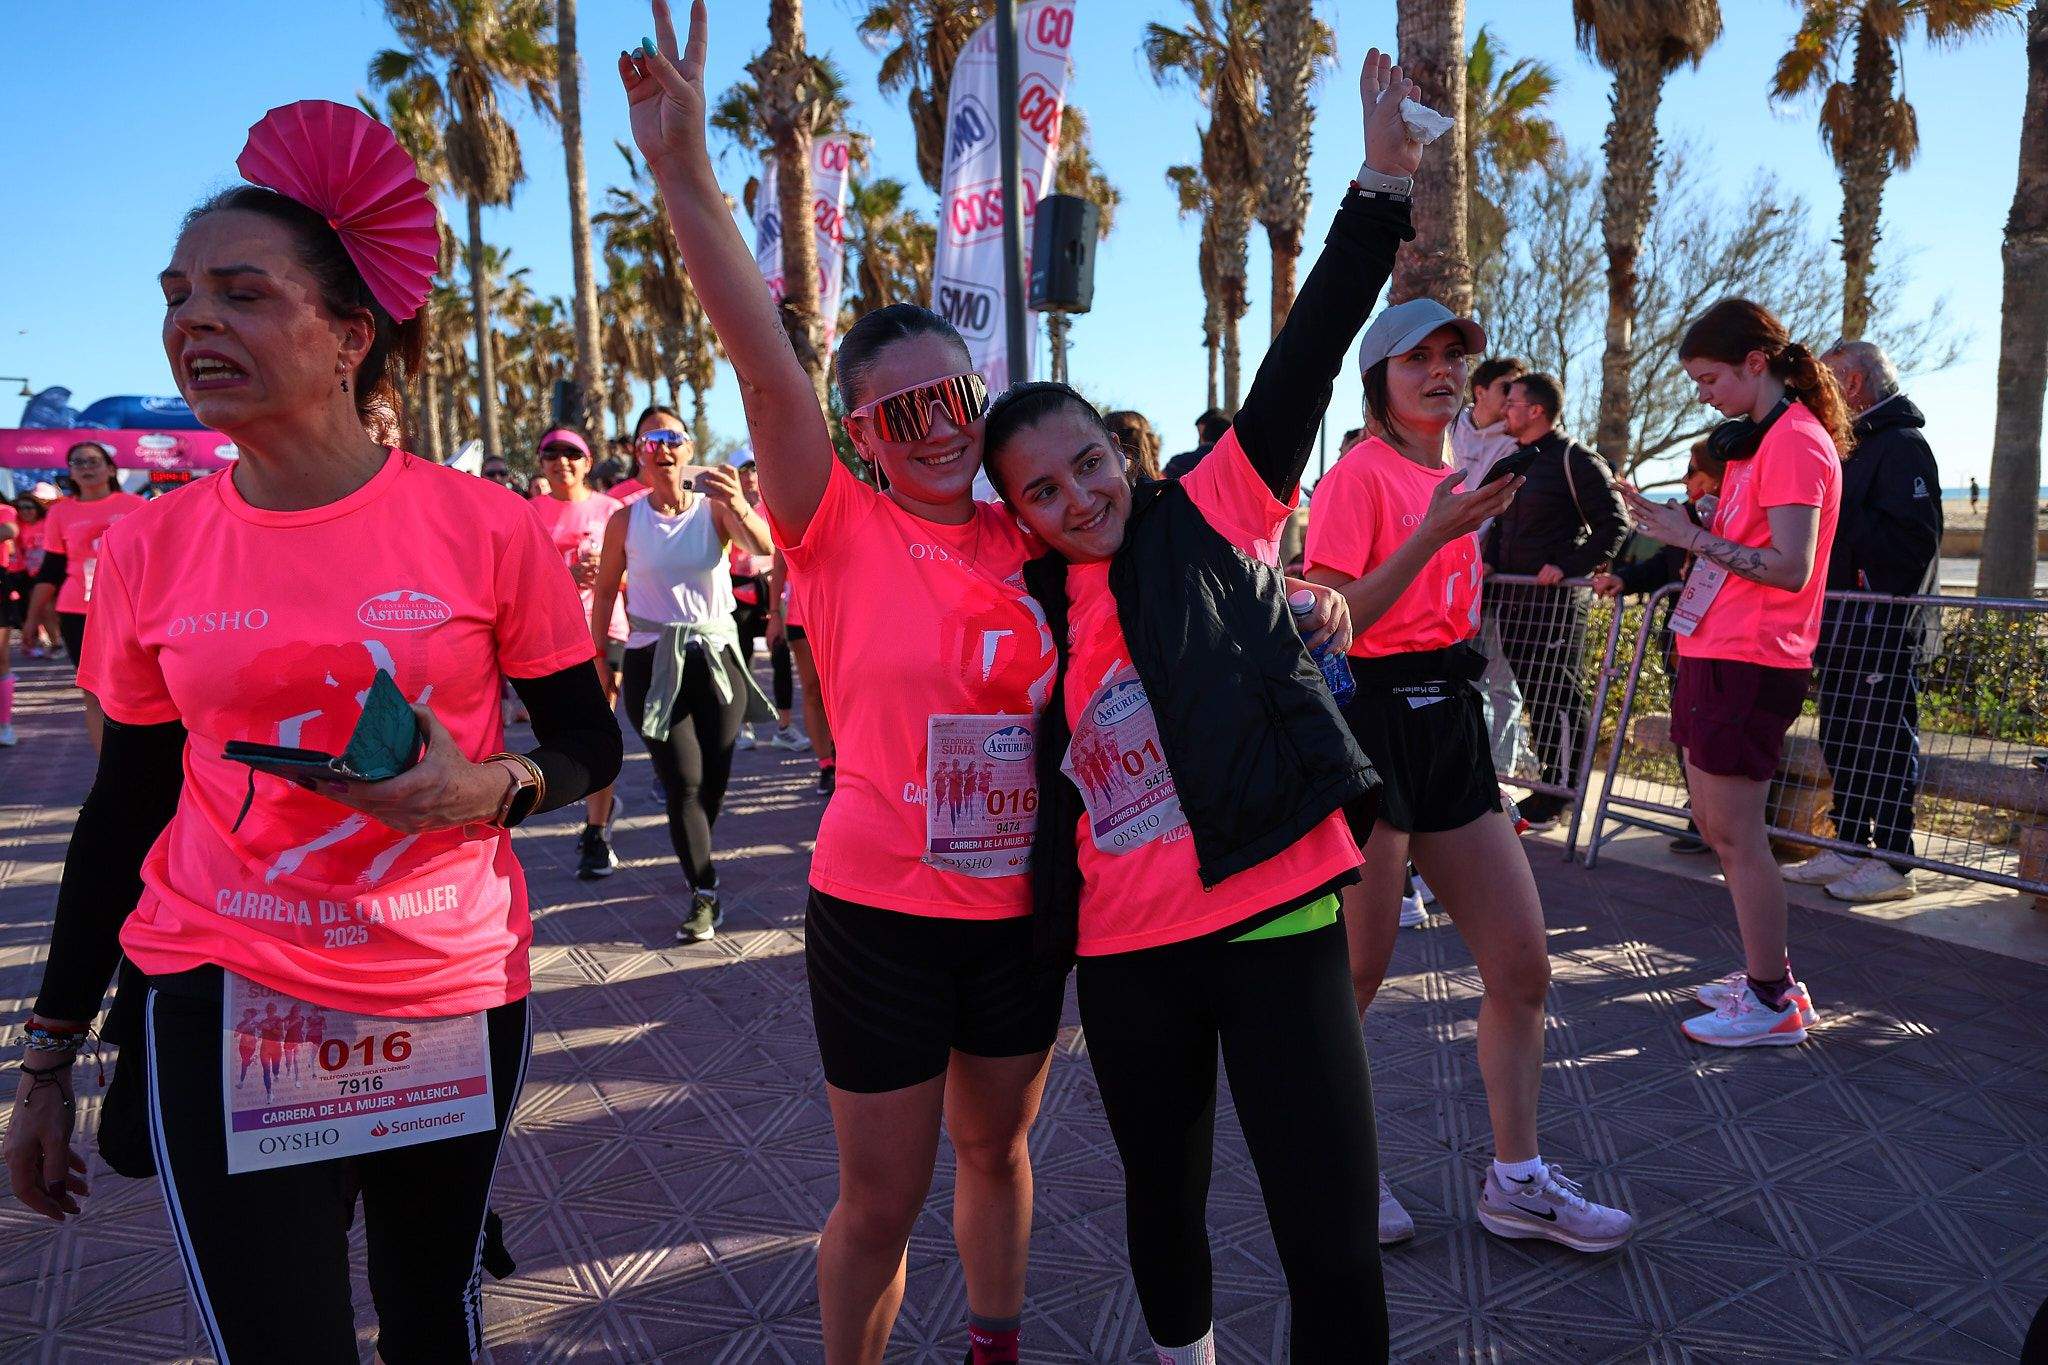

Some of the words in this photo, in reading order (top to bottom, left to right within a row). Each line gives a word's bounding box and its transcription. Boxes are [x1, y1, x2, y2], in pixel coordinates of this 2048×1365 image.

[1037, 6, 1074, 48] CO
[167, 608, 269, 637] OYSHO
[986, 788, 1038, 816] 016
[1109, 804, 1141, 826] CARRERA
[1141, 799, 1150, 810] DE
[1150, 793, 1160, 804] LA
[996, 821, 1021, 835] 9474
[1113, 814, 1160, 847] OYSHO
[950, 840, 982, 850] CARRERA
[984, 839, 993, 848] DE
[994, 838, 1003, 847] LA
[1003, 837, 1025, 847] MUJER
[215, 888, 313, 927] CARRERA
[319, 900, 351, 925] DE
[387, 884, 459, 922] MUJER
[323, 925, 369, 949] 2025
[318, 1030, 413, 1073] 016
[337, 1075, 384, 1096] 7916
[262, 1102, 316, 1125] CARRERA
[319, 1103, 336, 1117] DE
[338, 1102, 353, 1114] LA
[356, 1096, 396, 1112] MUJER
[406, 1085, 460, 1104] VALENCIA
[390, 1111, 466, 1135] Santander
[258, 1127, 340, 1155] OYSHO
